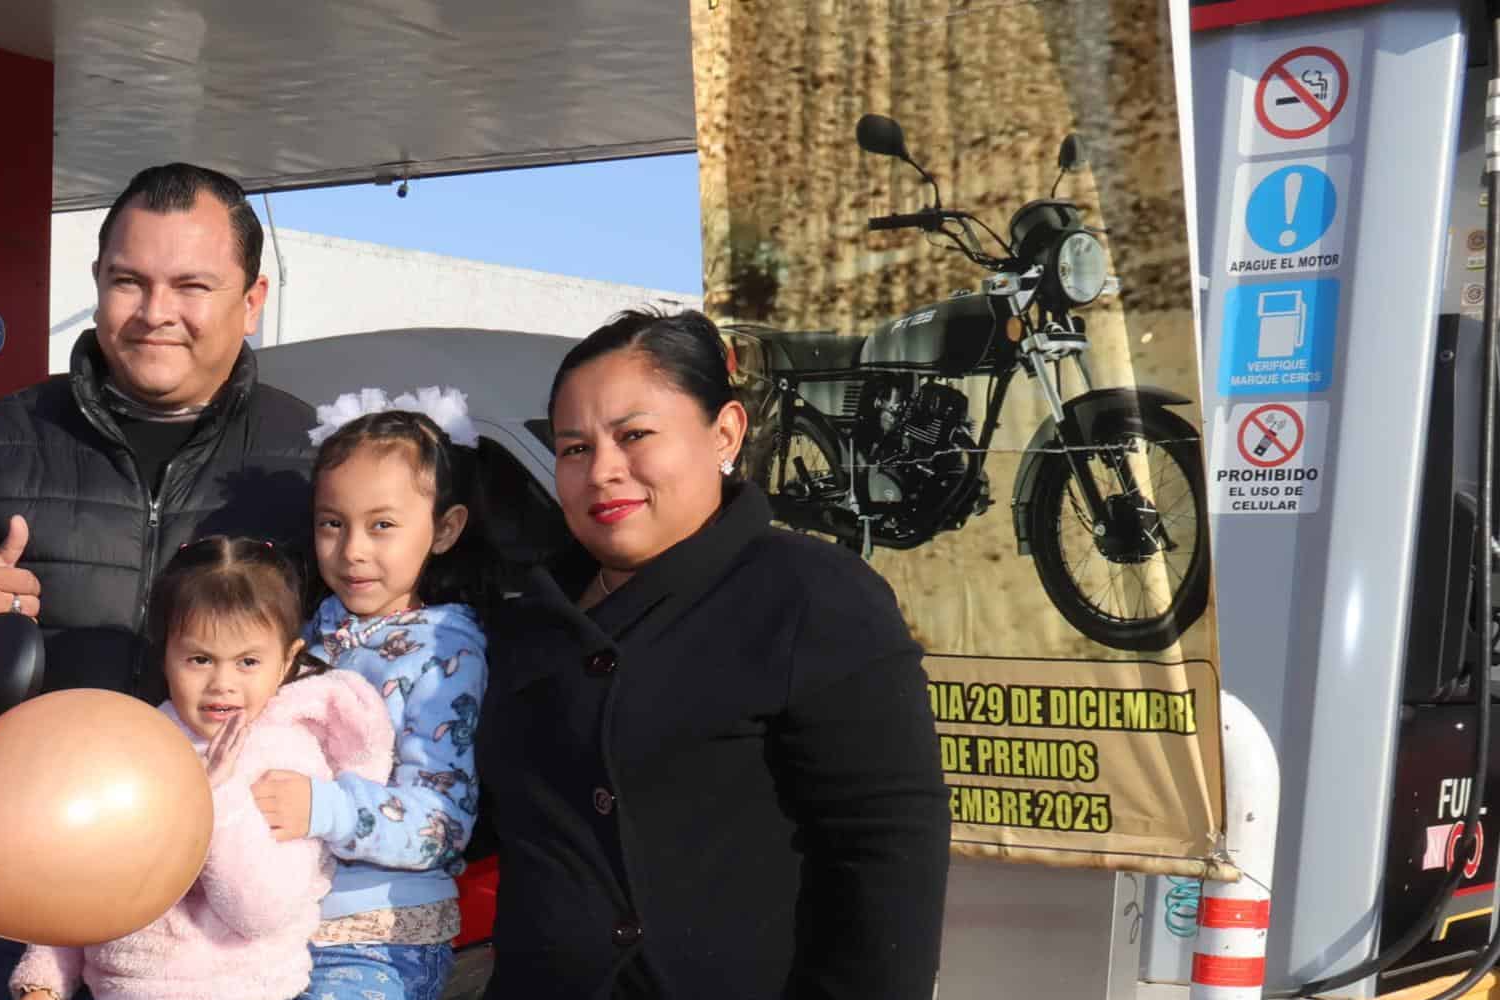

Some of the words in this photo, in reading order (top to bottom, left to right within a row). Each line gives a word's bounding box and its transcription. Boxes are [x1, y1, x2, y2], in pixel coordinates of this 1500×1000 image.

[1230, 259, 1277, 272] APAGUE
[1280, 258, 1295, 270] EL
[1298, 254, 1340, 267] MOTOR
[1246, 359, 1309, 372] VERIFIQUE
[1230, 373, 1279, 385] MARQUE
[1217, 468, 1319, 482] PROHIBIDO
[1229, 487, 1246, 497] EL
[1250, 486, 1280, 497] USO
[1284, 486, 1304, 496] DE
[1231, 500, 1298, 511] CELULAR
[969, 684, 1005, 723] 29
[1010, 686, 1044, 727] DE
[940, 735, 972, 773] DE
[975, 737, 1098, 781] PREMIOS
[949, 786, 1033, 827] EMBRE
[1036, 792, 1111, 832] 2025
